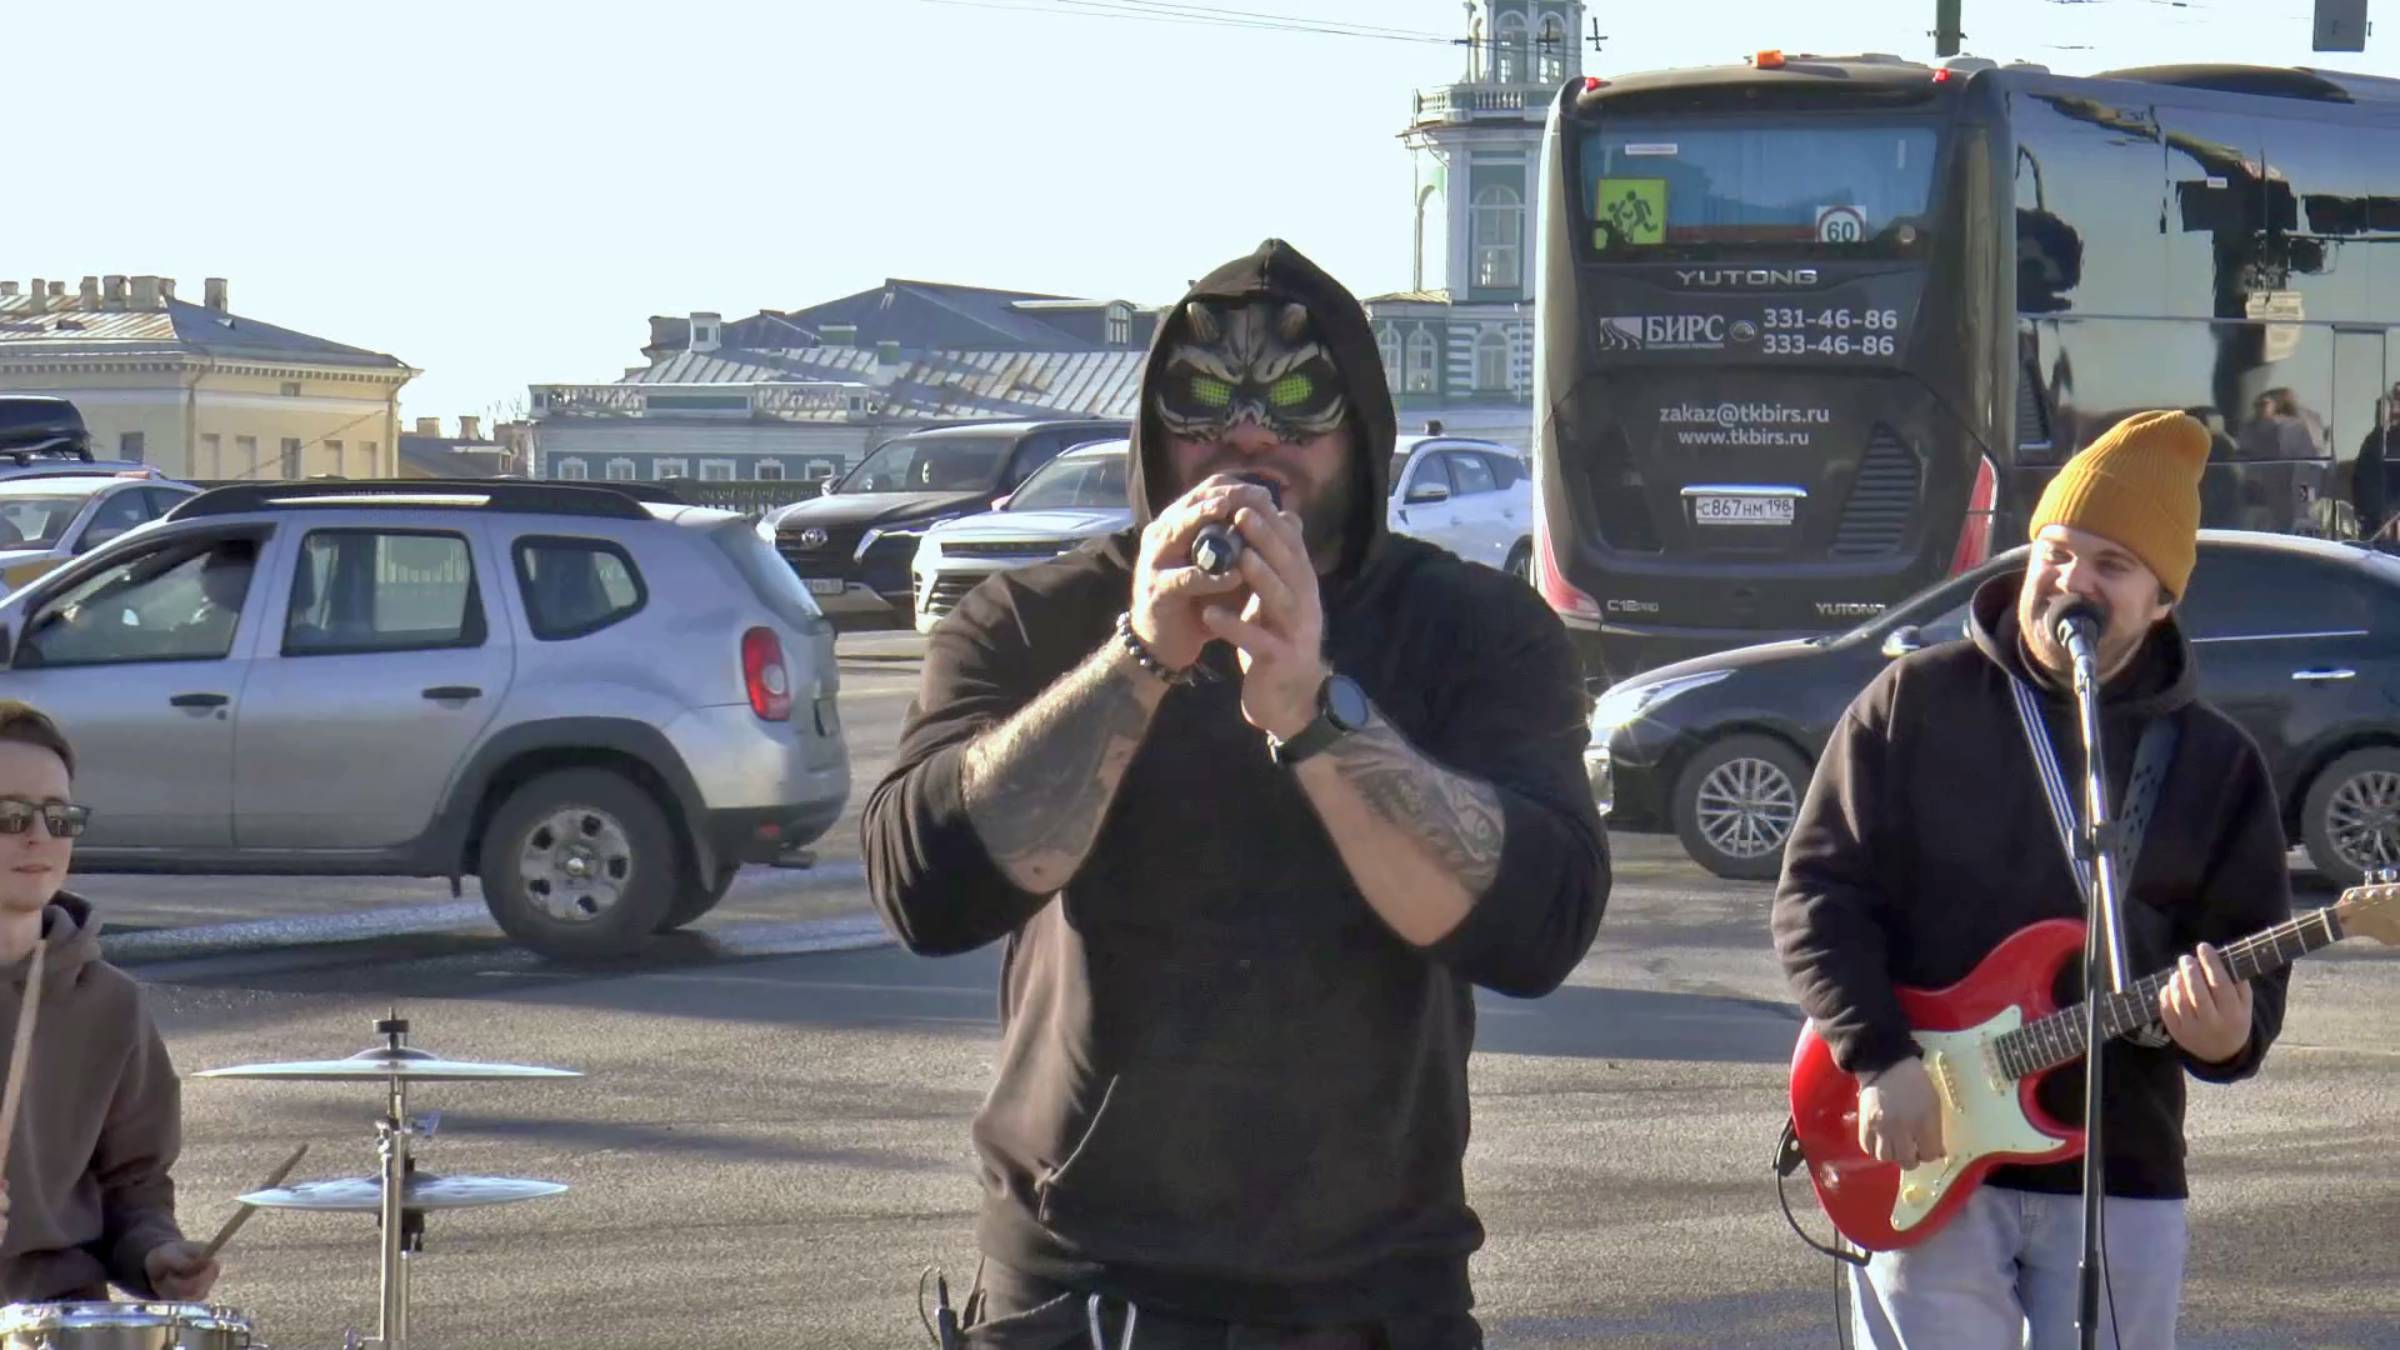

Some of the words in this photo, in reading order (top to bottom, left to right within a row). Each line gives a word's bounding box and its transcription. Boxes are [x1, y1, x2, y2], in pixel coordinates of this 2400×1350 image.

[1827, 221, 1855, 242] 60
[1675, 269, 1819, 286] YUTONG
[1646, 314, 1725, 342] БИРС
[1762, 308, 1898, 330] 331-46-86
[1762, 335, 1895, 356] 333-46-86
[1659, 403, 1830, 428] zakaz@tkbirs.ru
[1678, 428, 1809, 446] www.tkbirs.ru
